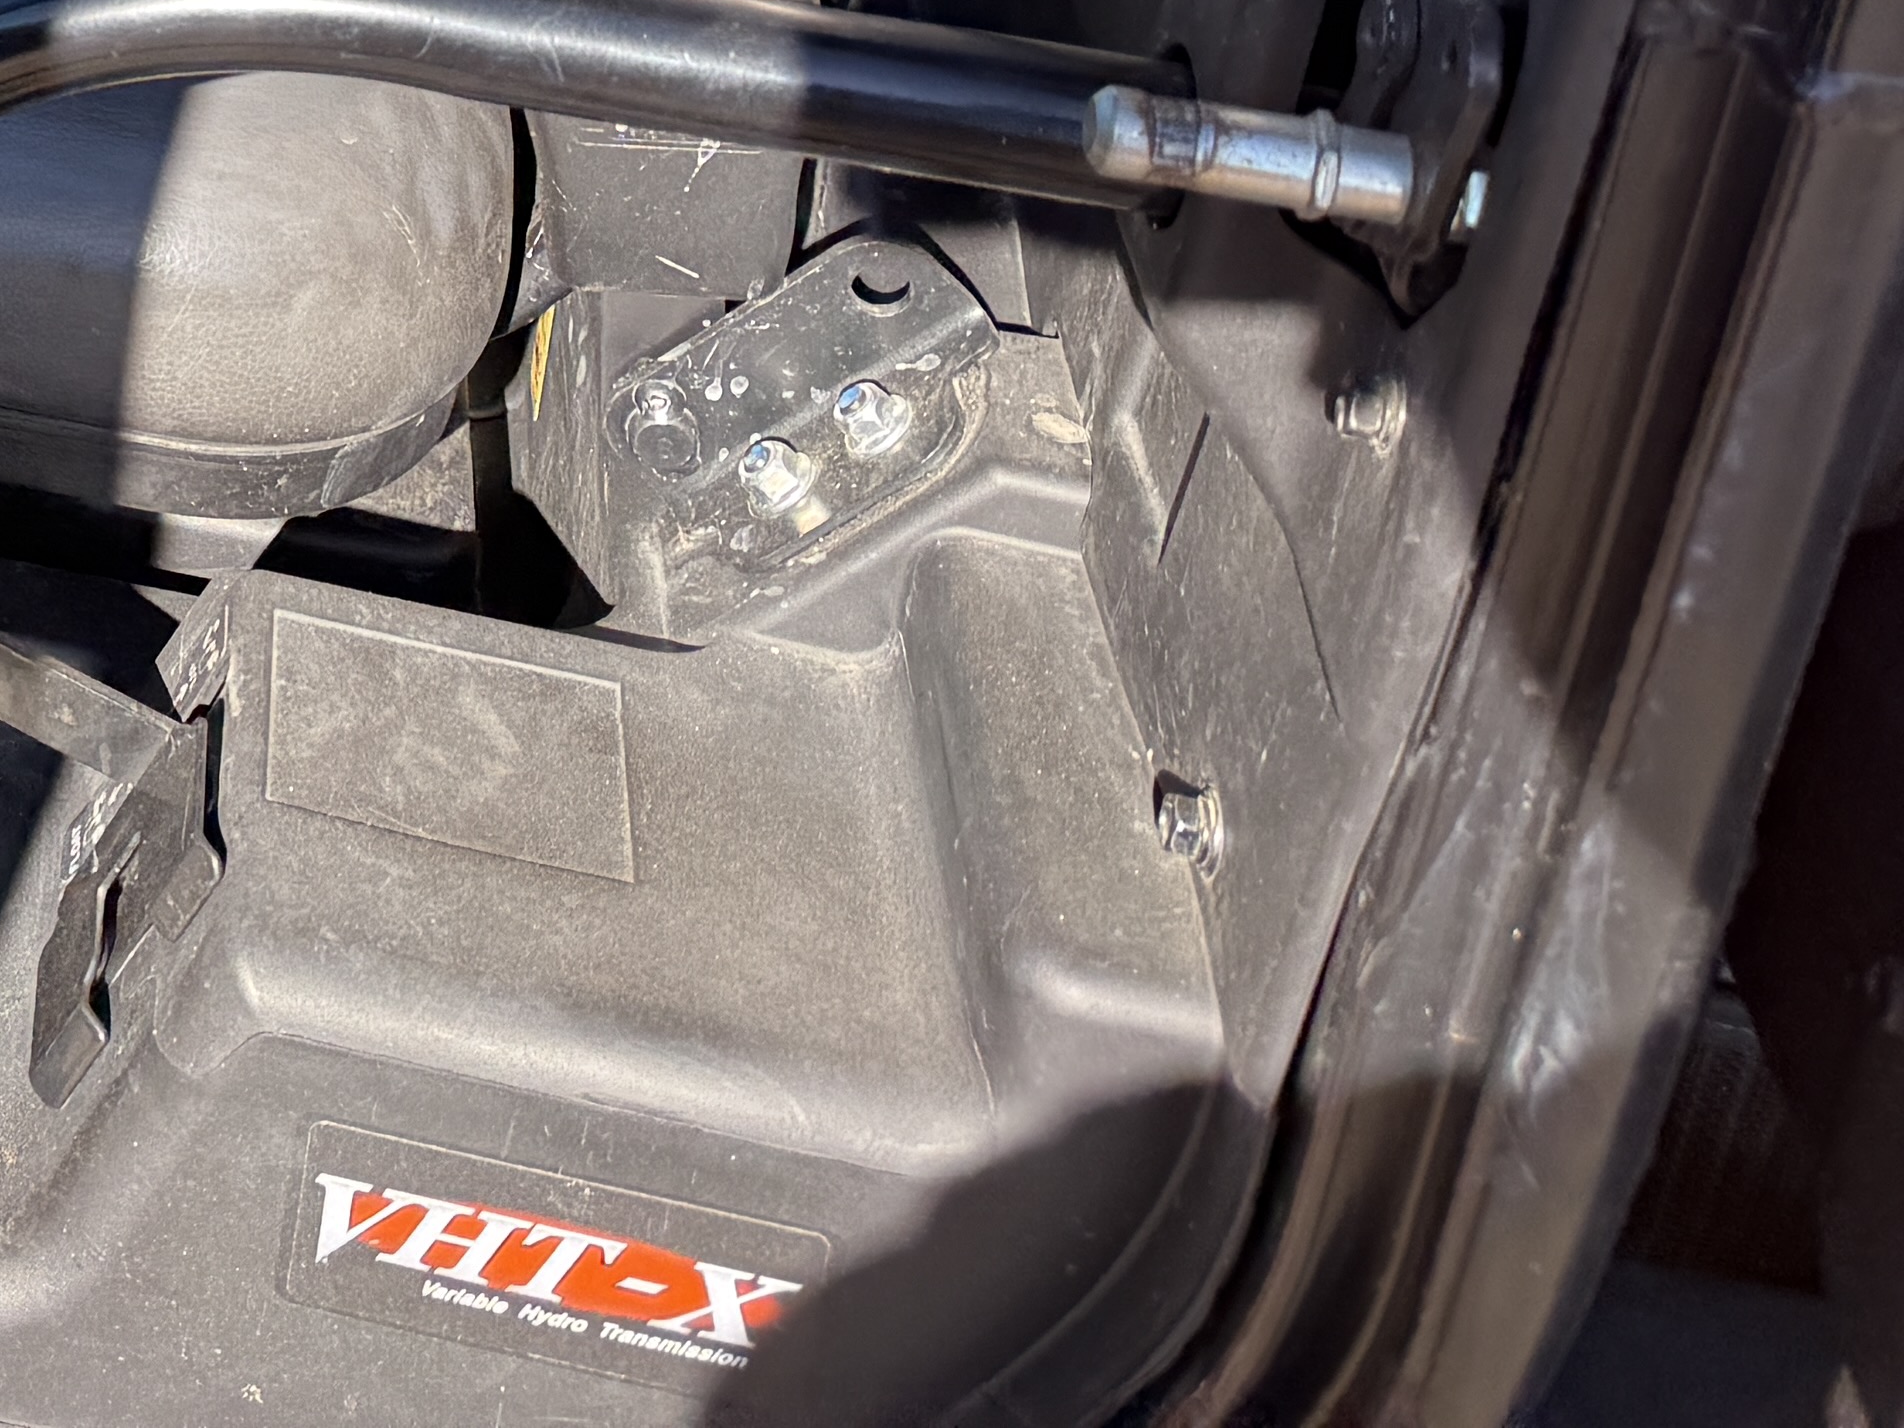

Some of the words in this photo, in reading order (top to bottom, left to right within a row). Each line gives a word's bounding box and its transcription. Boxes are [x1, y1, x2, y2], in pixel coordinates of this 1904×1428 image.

[314, 1171, 803, 1350] VHT-X
[421, 1278, 510, 1316] Variable
[517, 1302, 588, 1336] Hydro
[599, 1320, 749, 1370] Transmission
